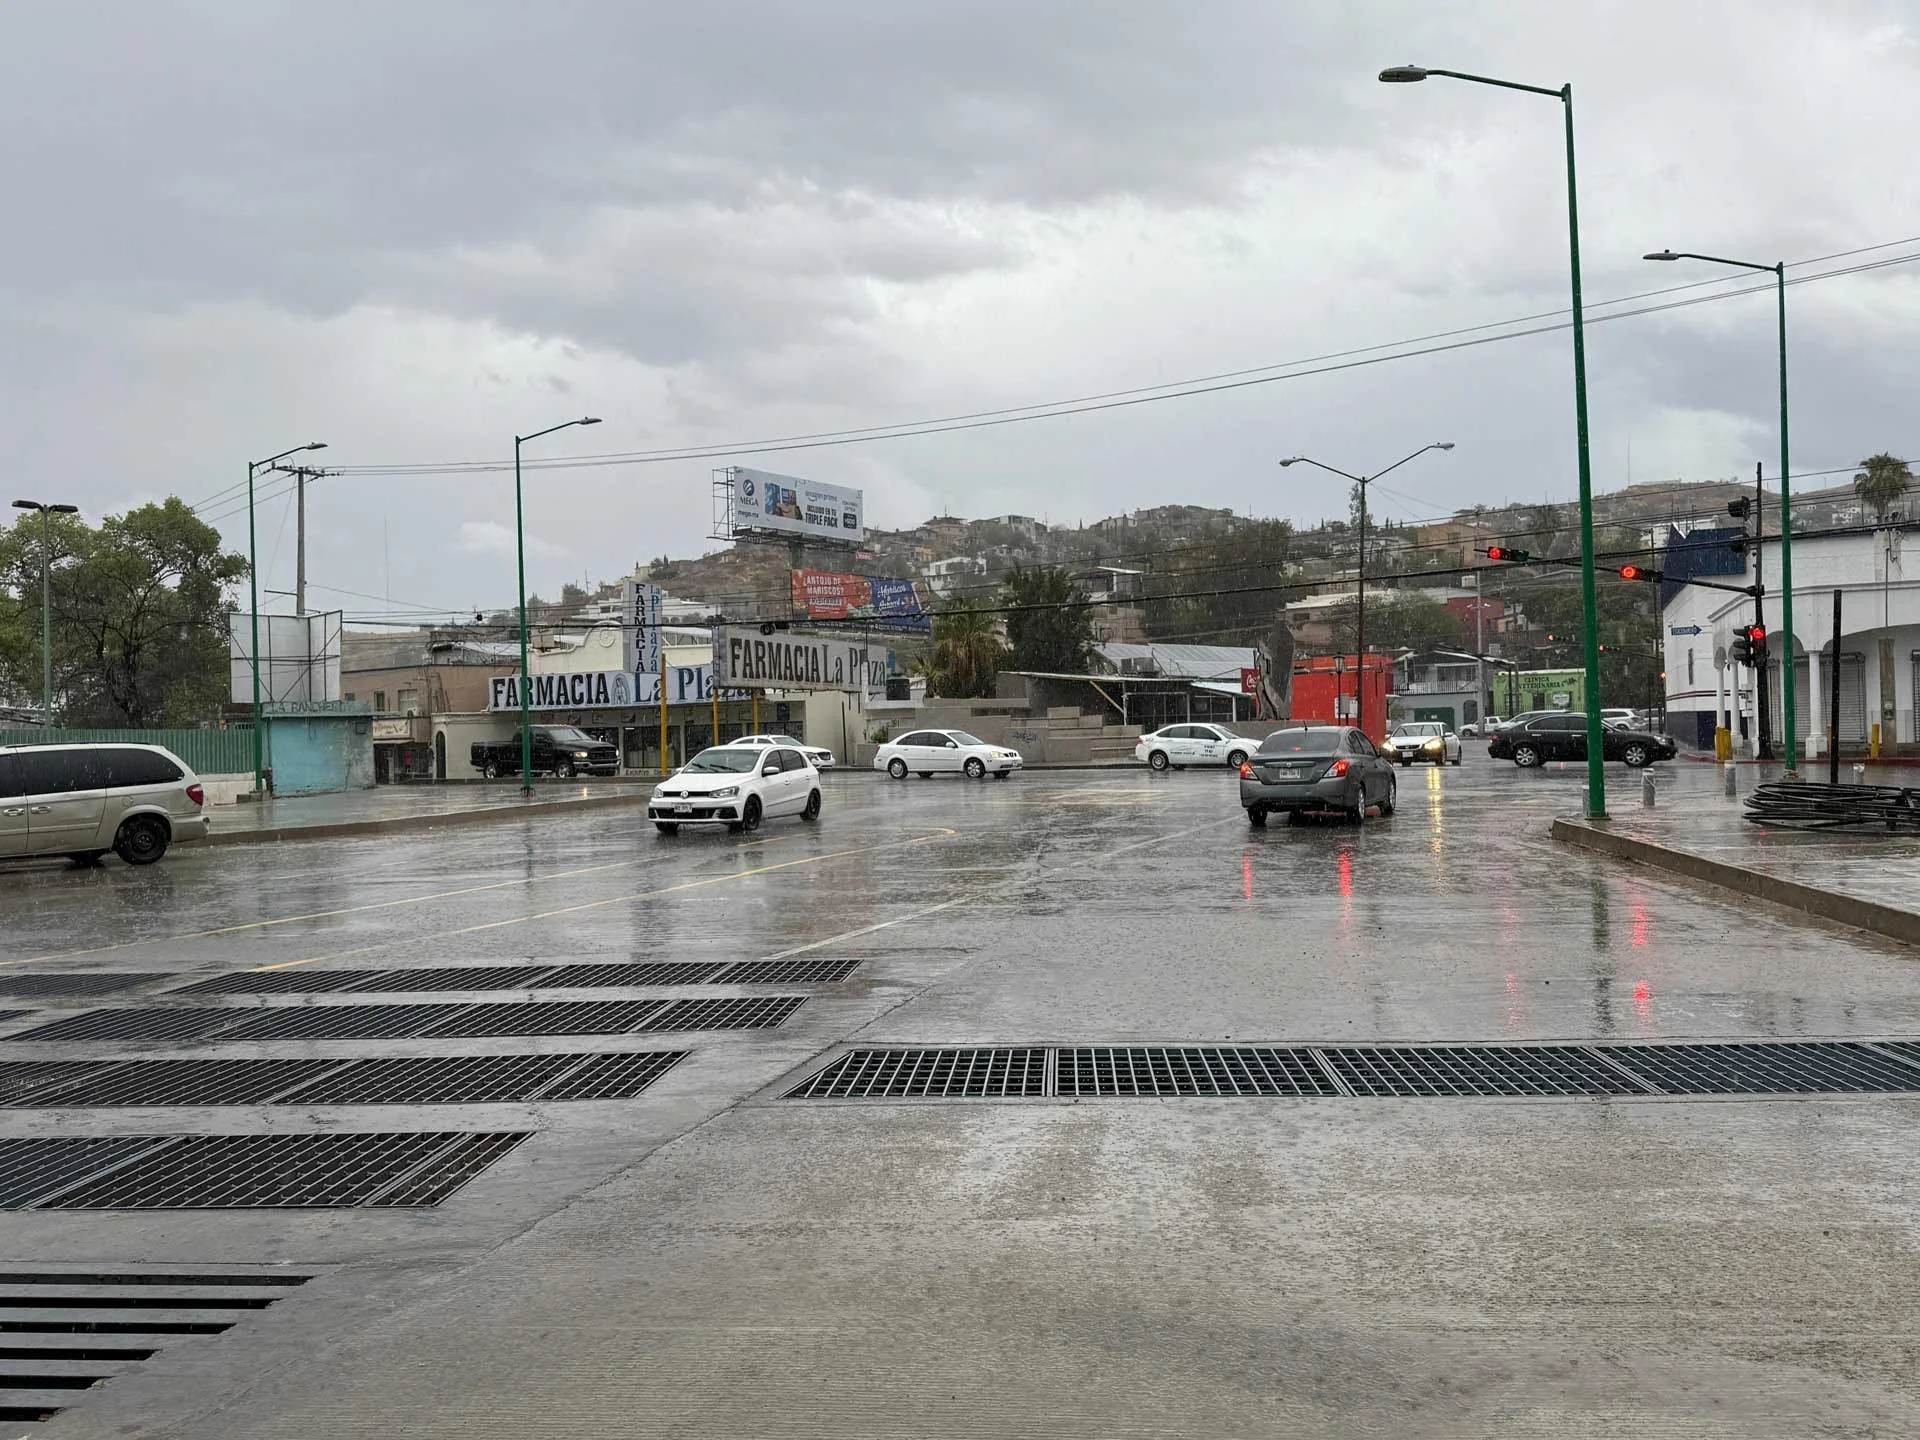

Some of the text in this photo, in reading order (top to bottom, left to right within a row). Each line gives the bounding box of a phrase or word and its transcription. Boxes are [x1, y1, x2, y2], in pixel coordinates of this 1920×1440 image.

[740, 497, 759, 507] MEGA
[805, 512, 823, 526] TRIPLE
[823, 516, 838, 529] PACK
[806, 586, 844, 596] MARISCOS?
[634, 584, 646, 672] FARMACIA
[650, 585, 660, 673] La Plaza
[729, 638, 821, 683] FARMACIA
[821, 644, 843, 684] La
[493, 673, 610, 708] FARMACIA
[635, 673, 662, 703] La
